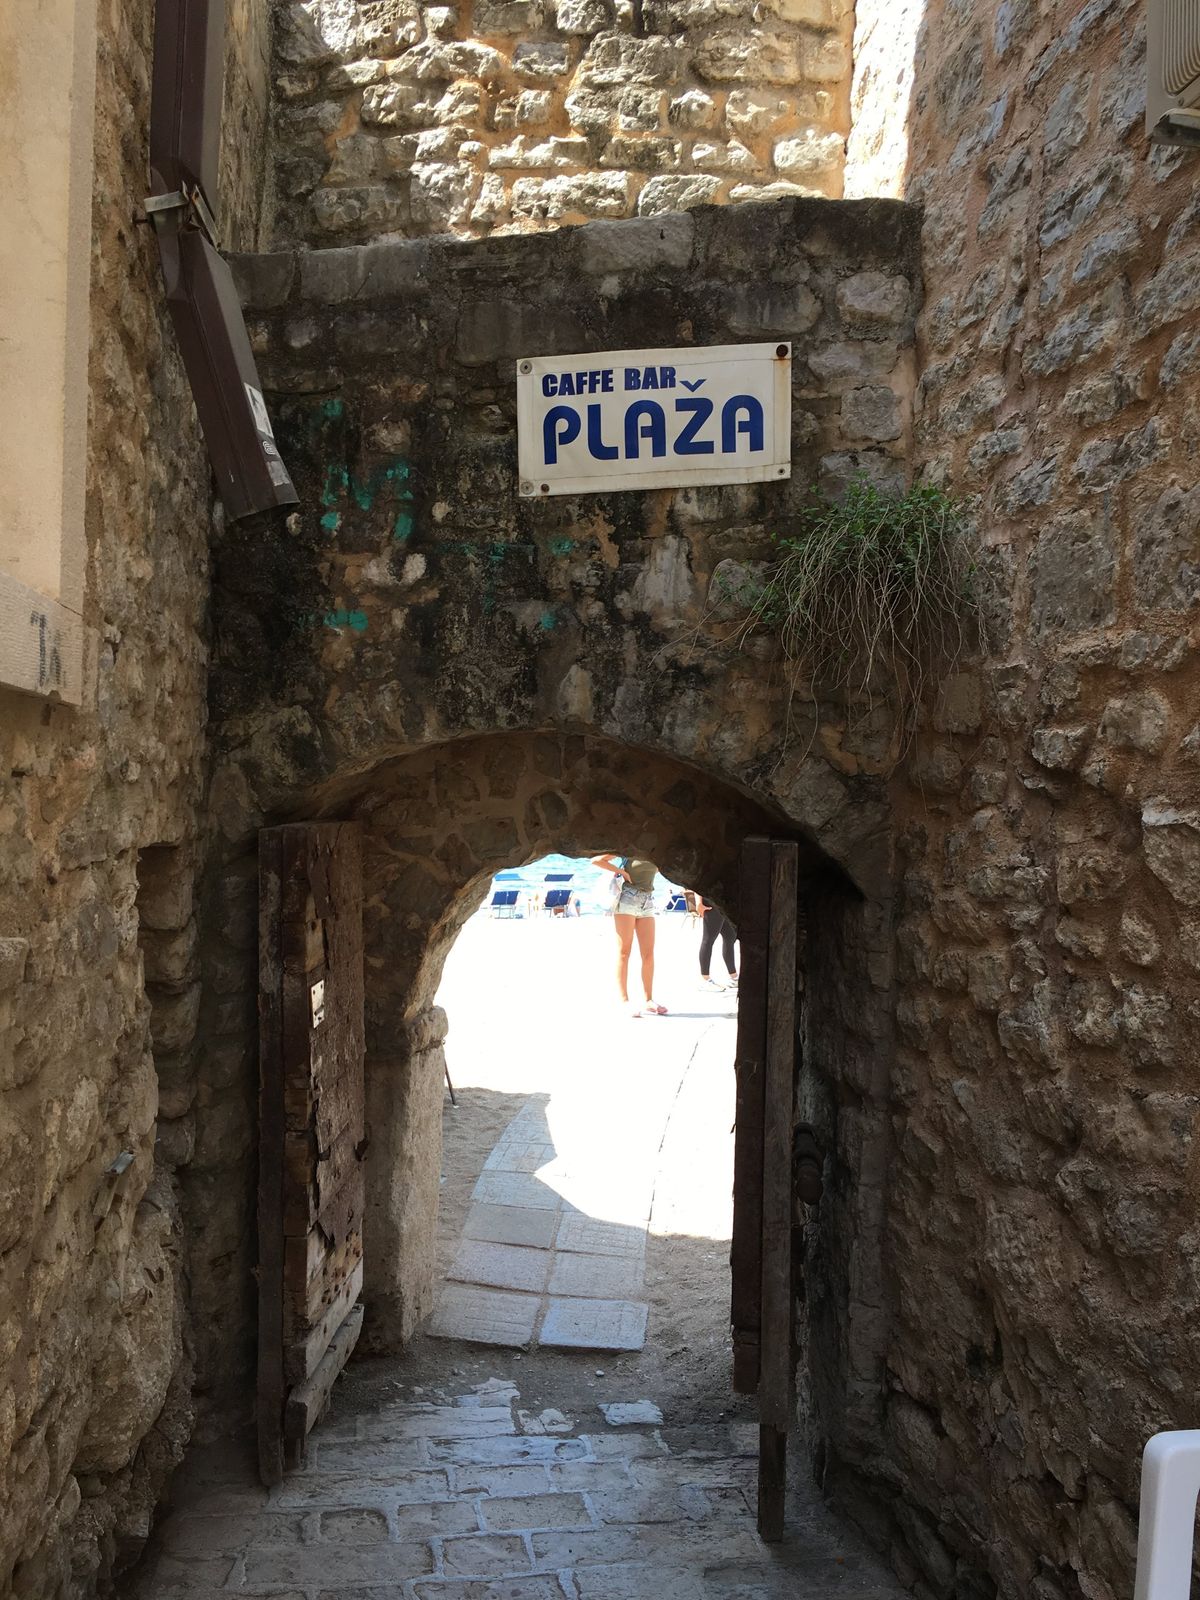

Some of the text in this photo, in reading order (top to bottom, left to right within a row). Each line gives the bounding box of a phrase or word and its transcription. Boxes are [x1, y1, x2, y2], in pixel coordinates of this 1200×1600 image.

[542, 366, 676, 397] CAFFE BAR
[543, 379, 764, 465] PLAŽA
